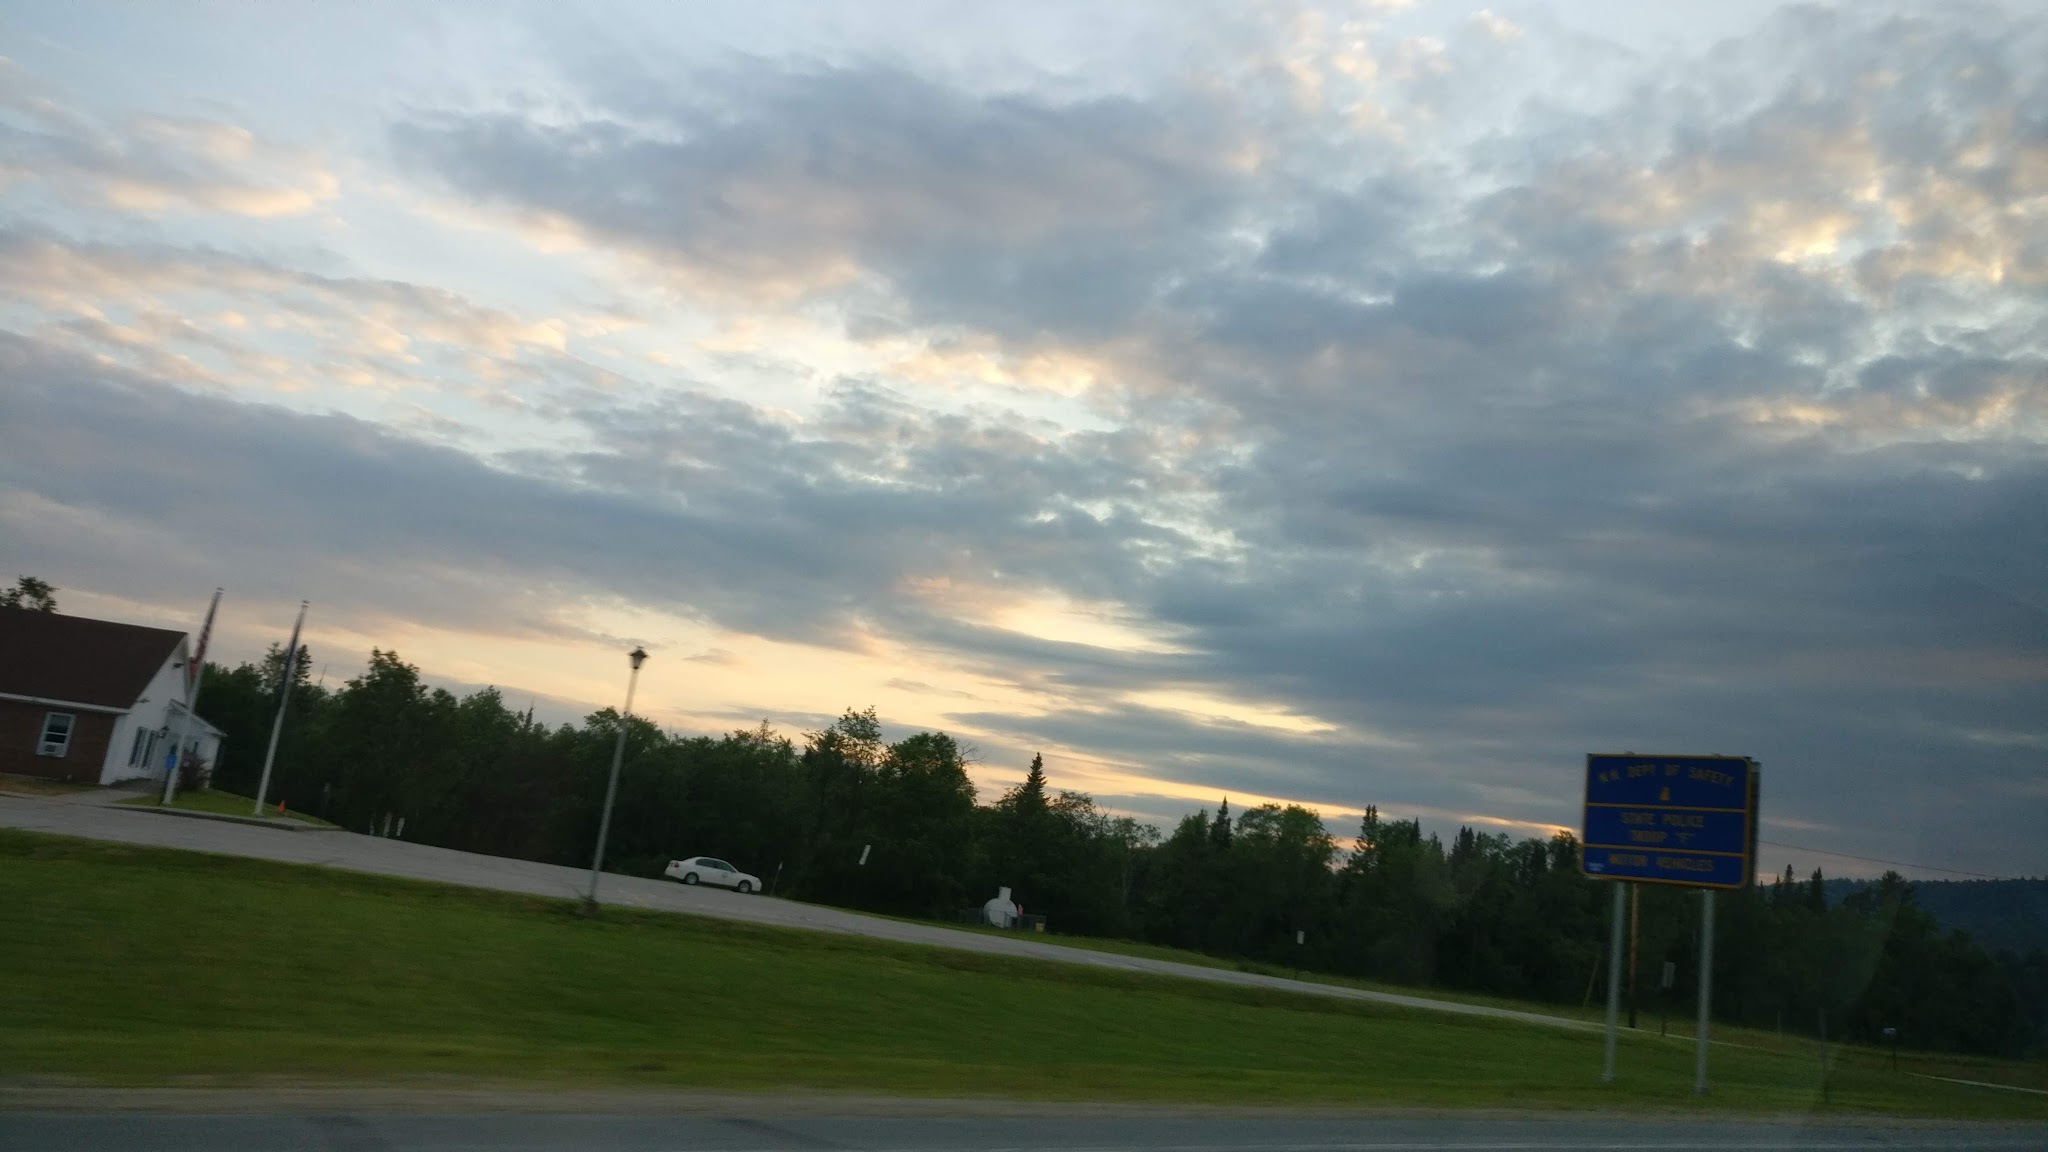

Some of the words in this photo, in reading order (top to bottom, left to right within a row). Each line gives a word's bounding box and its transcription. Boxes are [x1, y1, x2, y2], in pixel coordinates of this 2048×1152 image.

[1664, 764, 1680, 776] OF
[1688, 766, 1735, 786] SAFETY
[1620, 812, 1655, 825] STATE
[1662, 814, 1704, 828] POLICE
[1631, 830, 1668, 842] TROOP
[1608, 854, 1648, 867] MOTOR
[1656, 857, 1714, 872] VEHICLES
